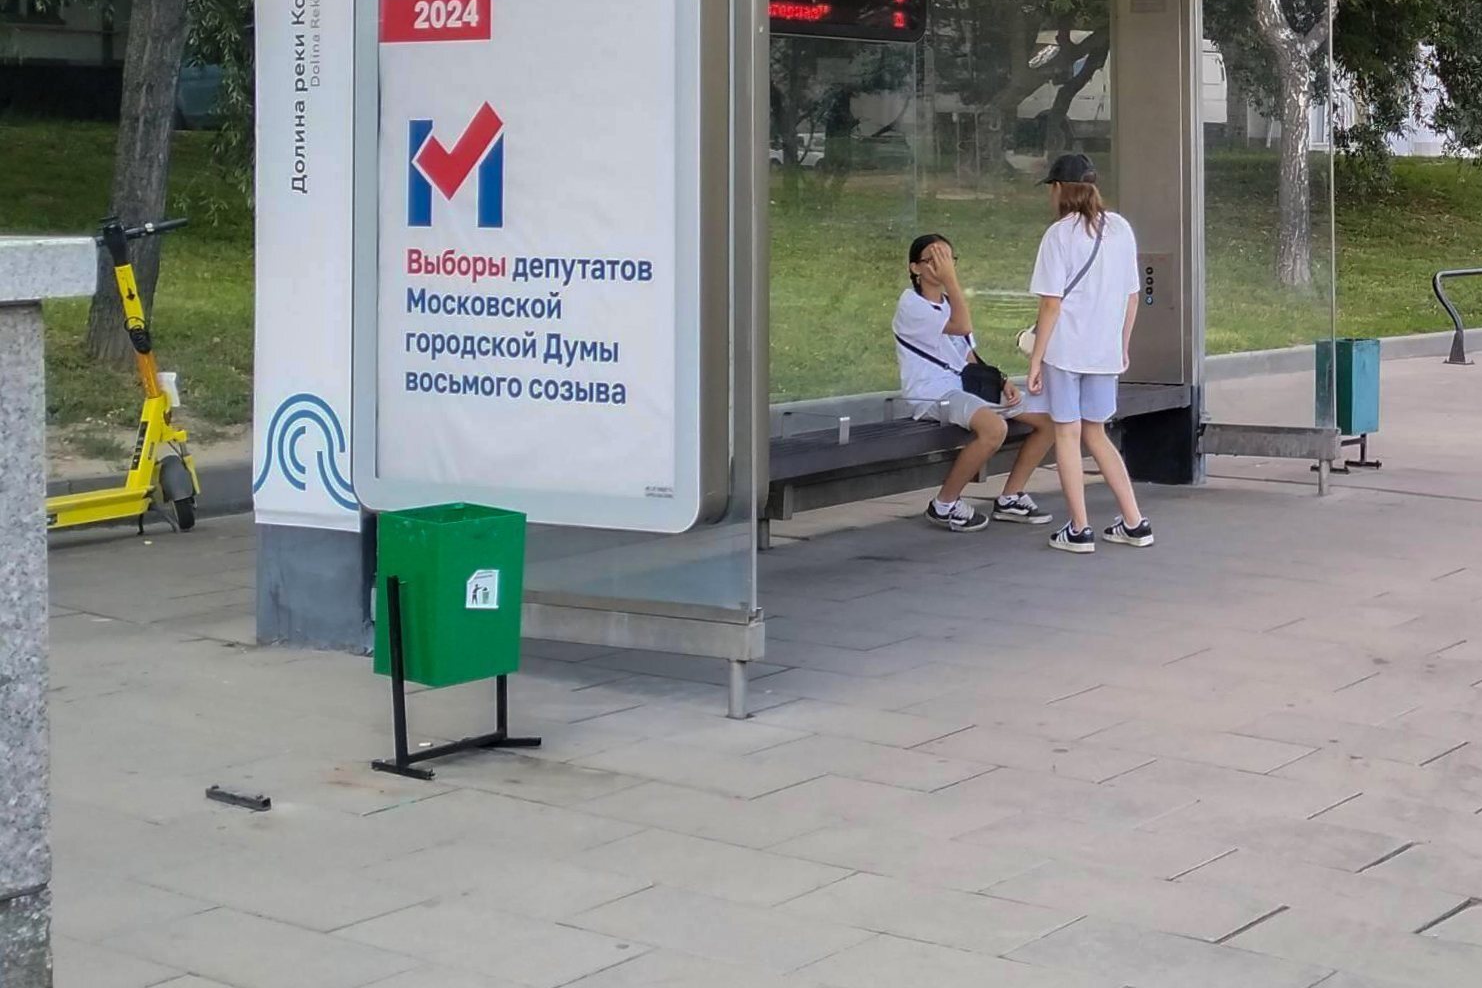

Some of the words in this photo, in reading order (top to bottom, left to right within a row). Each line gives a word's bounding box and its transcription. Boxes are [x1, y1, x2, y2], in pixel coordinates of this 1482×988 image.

[294, 34, 308, 92] реки
[310, 34, 321, 87] Dolina
[291, 100, 308, 194] Долина
[406, 248, 507, 283] Выборы
[512, 256, 653, 287] депутатов
[406, 287, 562, 319] Московской
[405, 330, 537, 361] городской
[543, 333, 619, 368] Думы
[405, 371, 523, 398] восьмого
[529, 378, 627, 405] созыва
